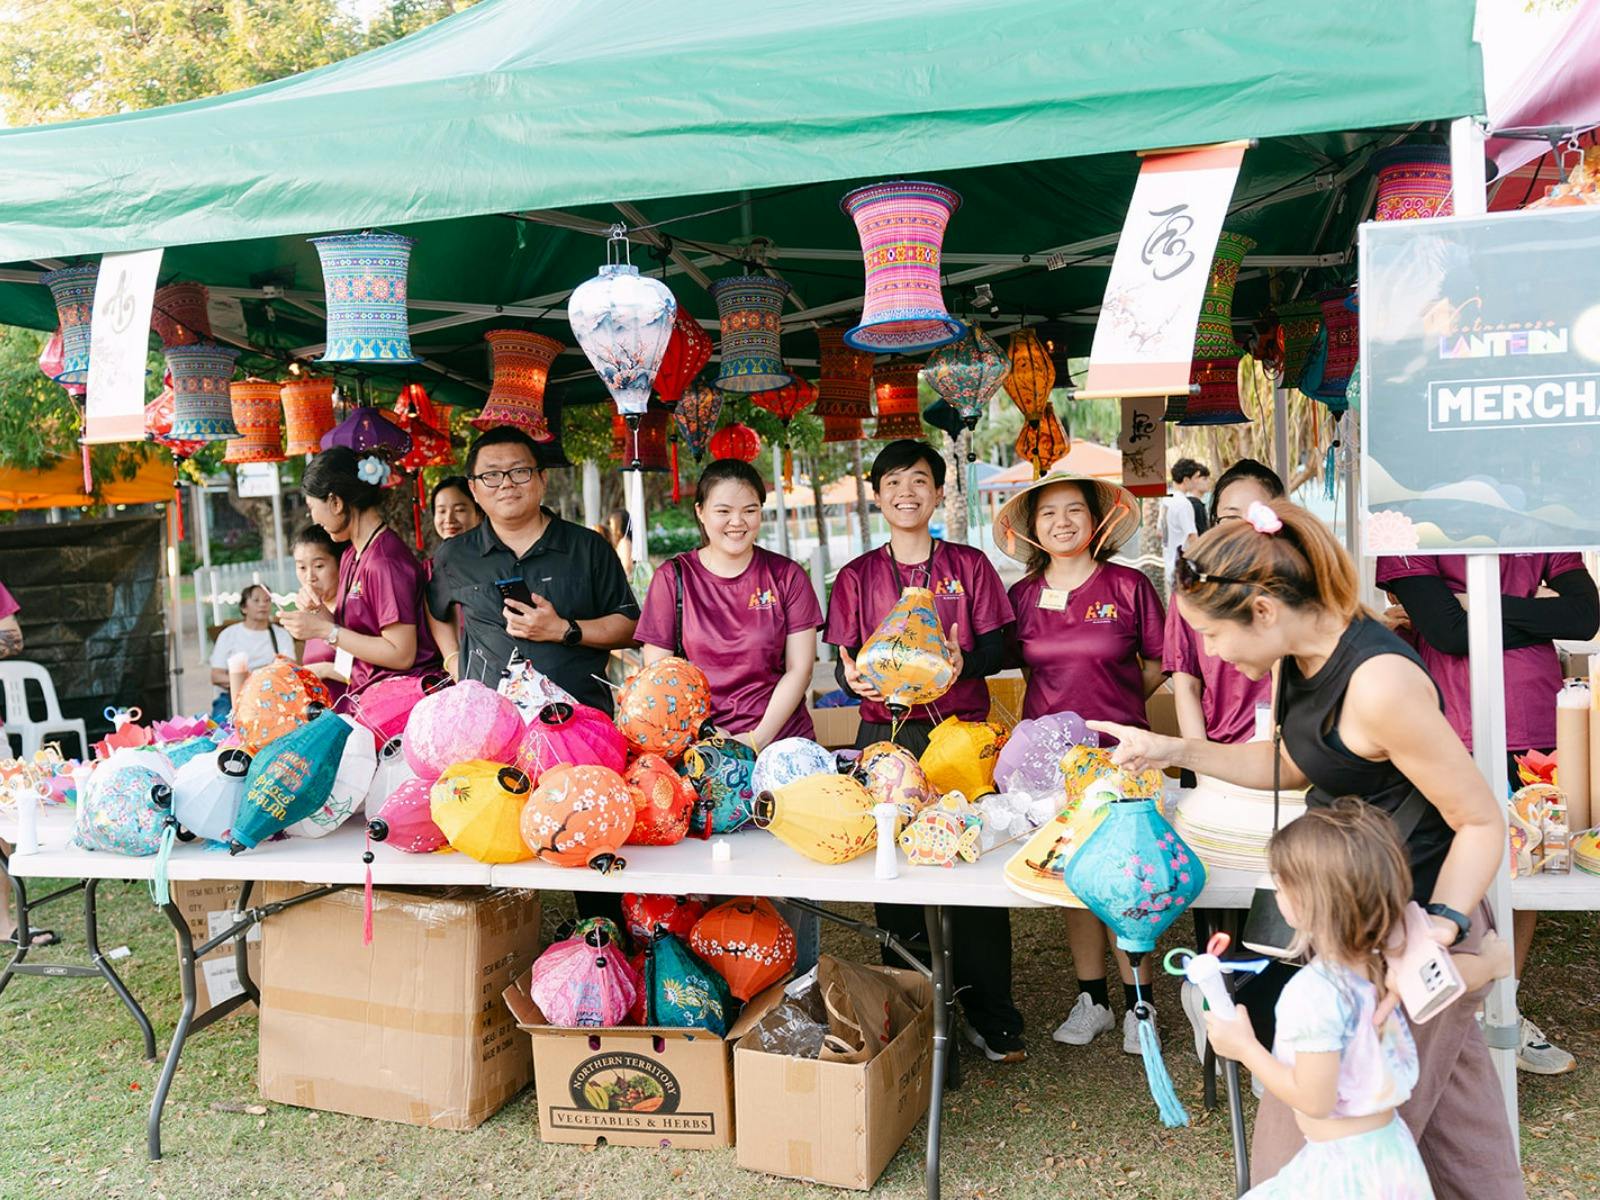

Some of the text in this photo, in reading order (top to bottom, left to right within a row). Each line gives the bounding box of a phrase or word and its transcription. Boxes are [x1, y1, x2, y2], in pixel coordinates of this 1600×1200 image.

[1440, 328, 1568, 359] LANTERN
[1438, 380, 1600, 423] MERCH
[573, 1056, 677, 1095] NORTHERN TERRITORY
[556, 1112, 708, 1129] VEGETABLES & HERBS
